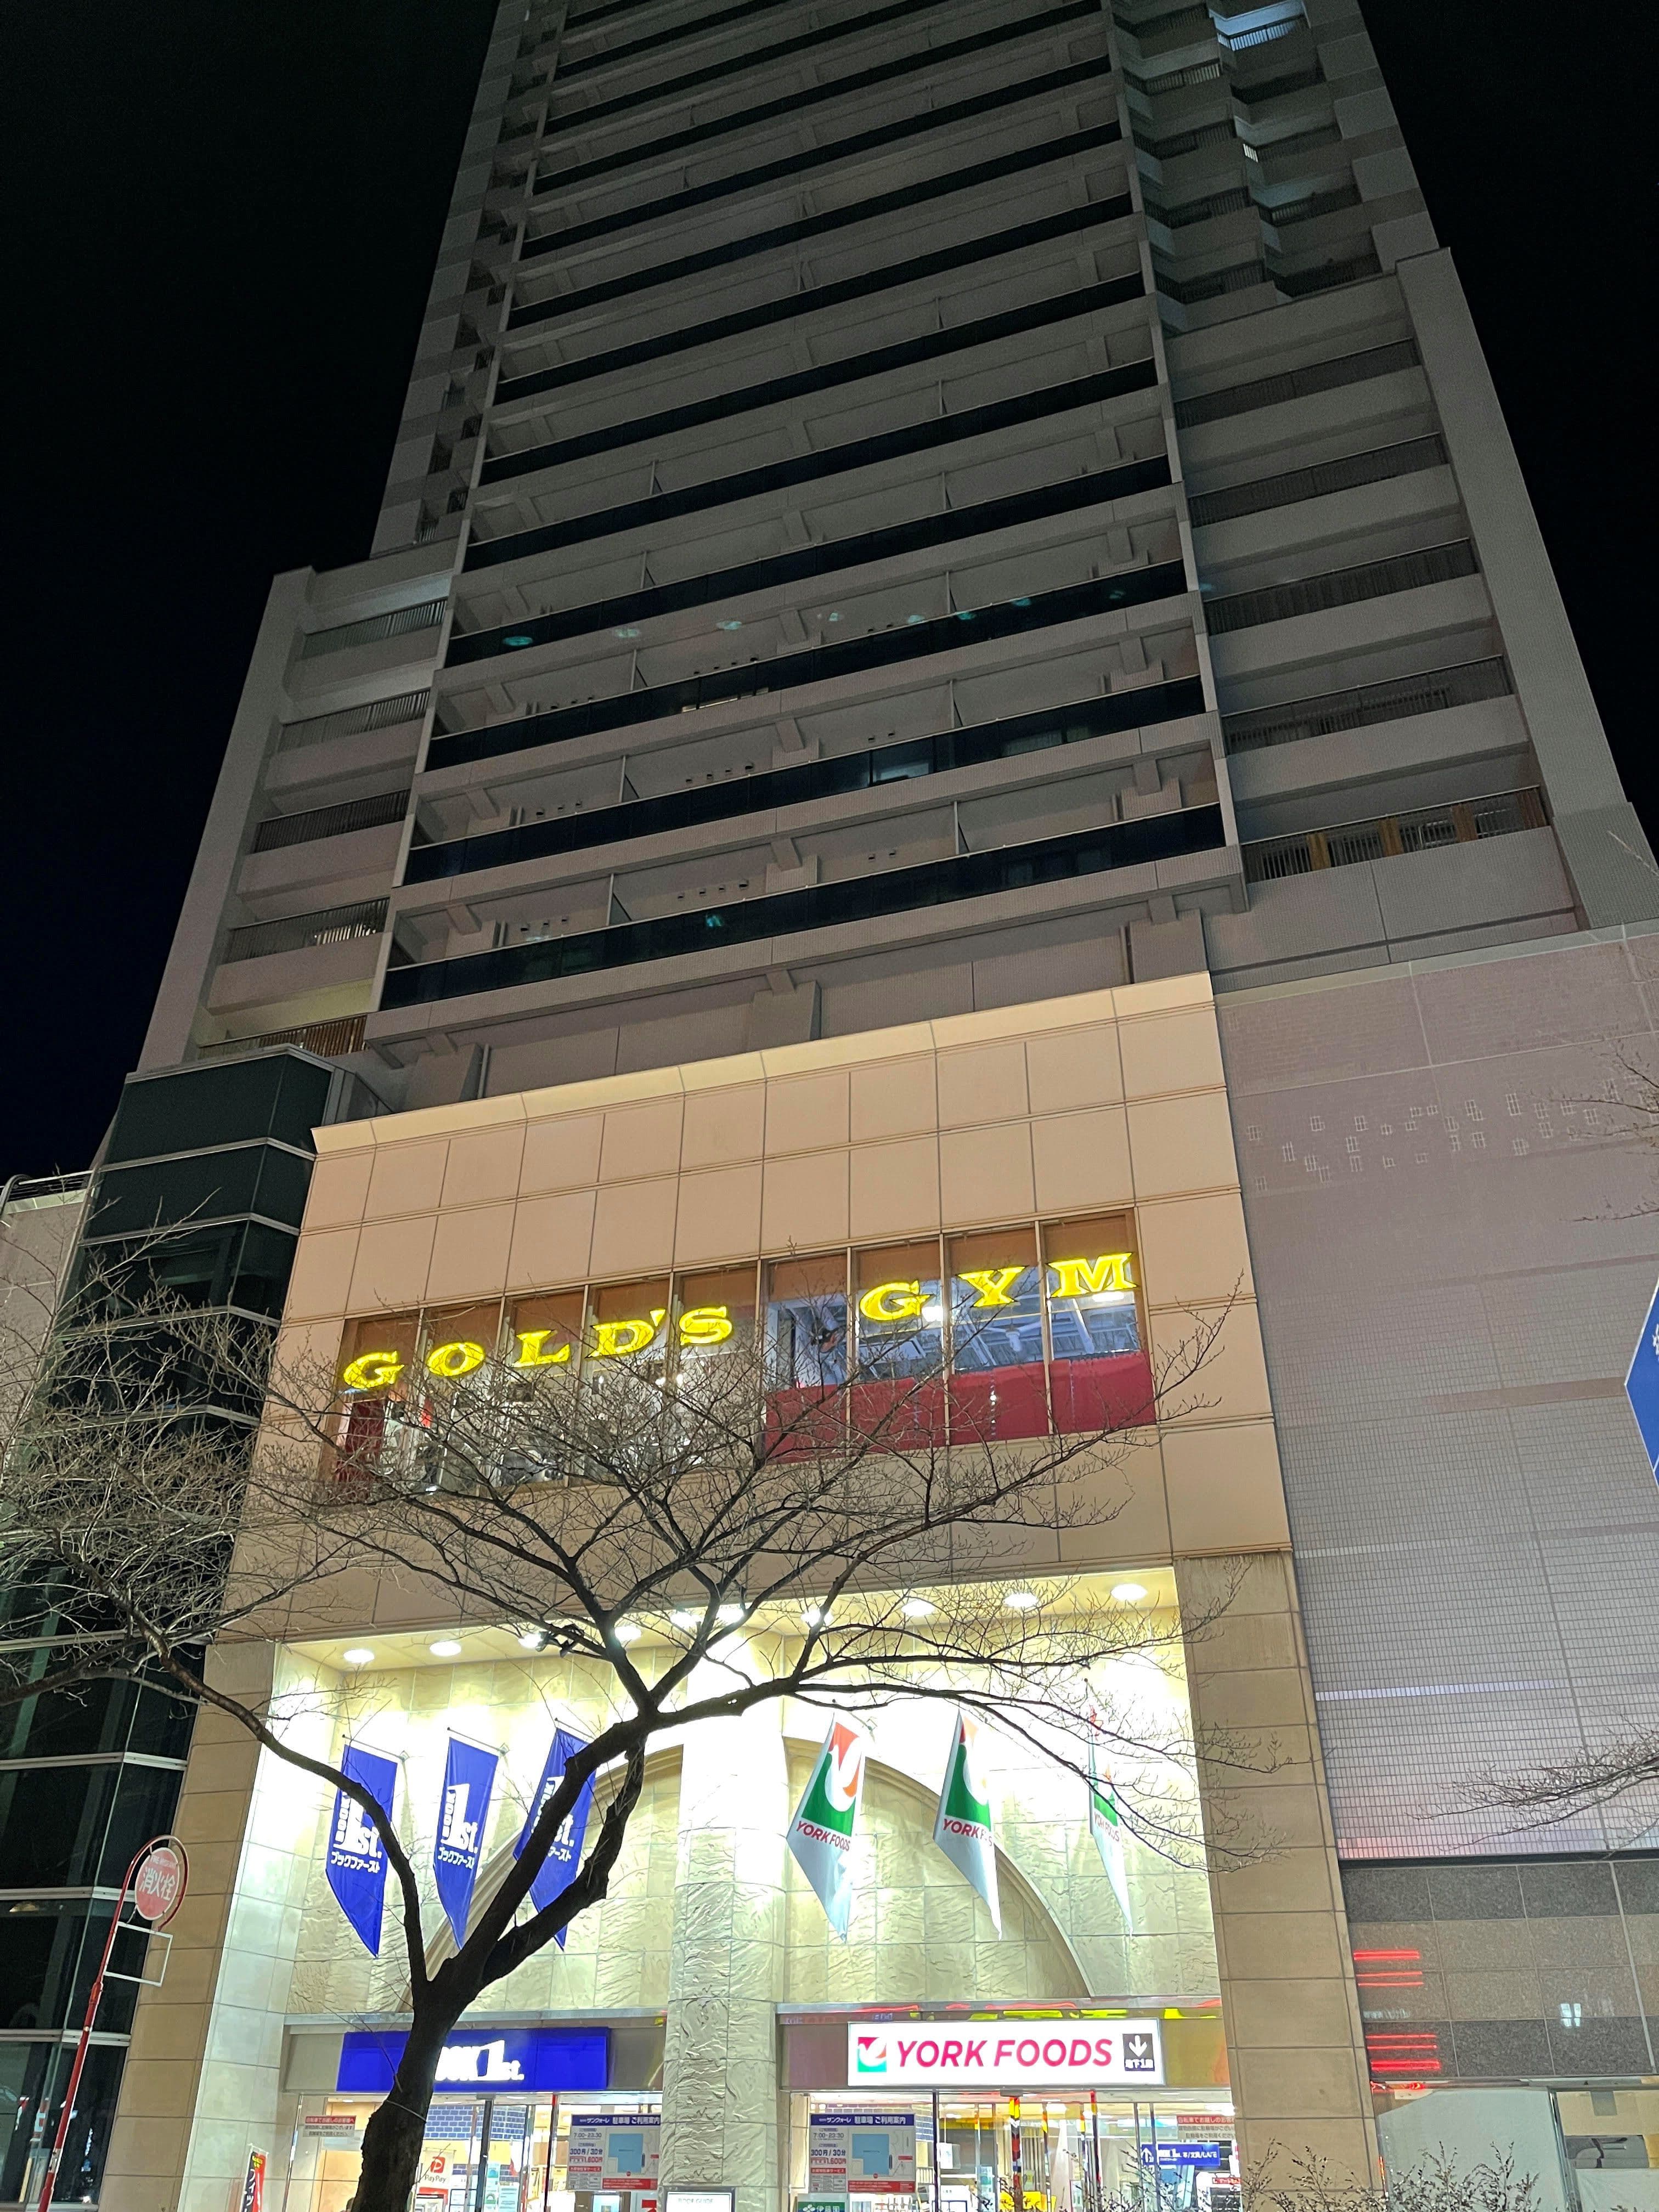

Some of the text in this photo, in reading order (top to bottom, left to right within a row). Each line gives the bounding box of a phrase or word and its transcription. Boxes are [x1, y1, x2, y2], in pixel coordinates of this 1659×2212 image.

[343, 1252, 1137, 1389] GOLD'S GYM
[797, 1820, 850, 1852] YORK FOODS
[943, 1818, 980, 1838] YORK
[331, 1851, 380, 1874] ブックファースト
[139, 1866, 175, 1901] 消火栓
[898, 2039, 1113, 2067] YORK FOODS
[425, 2174, 446, 2183] PayPay
